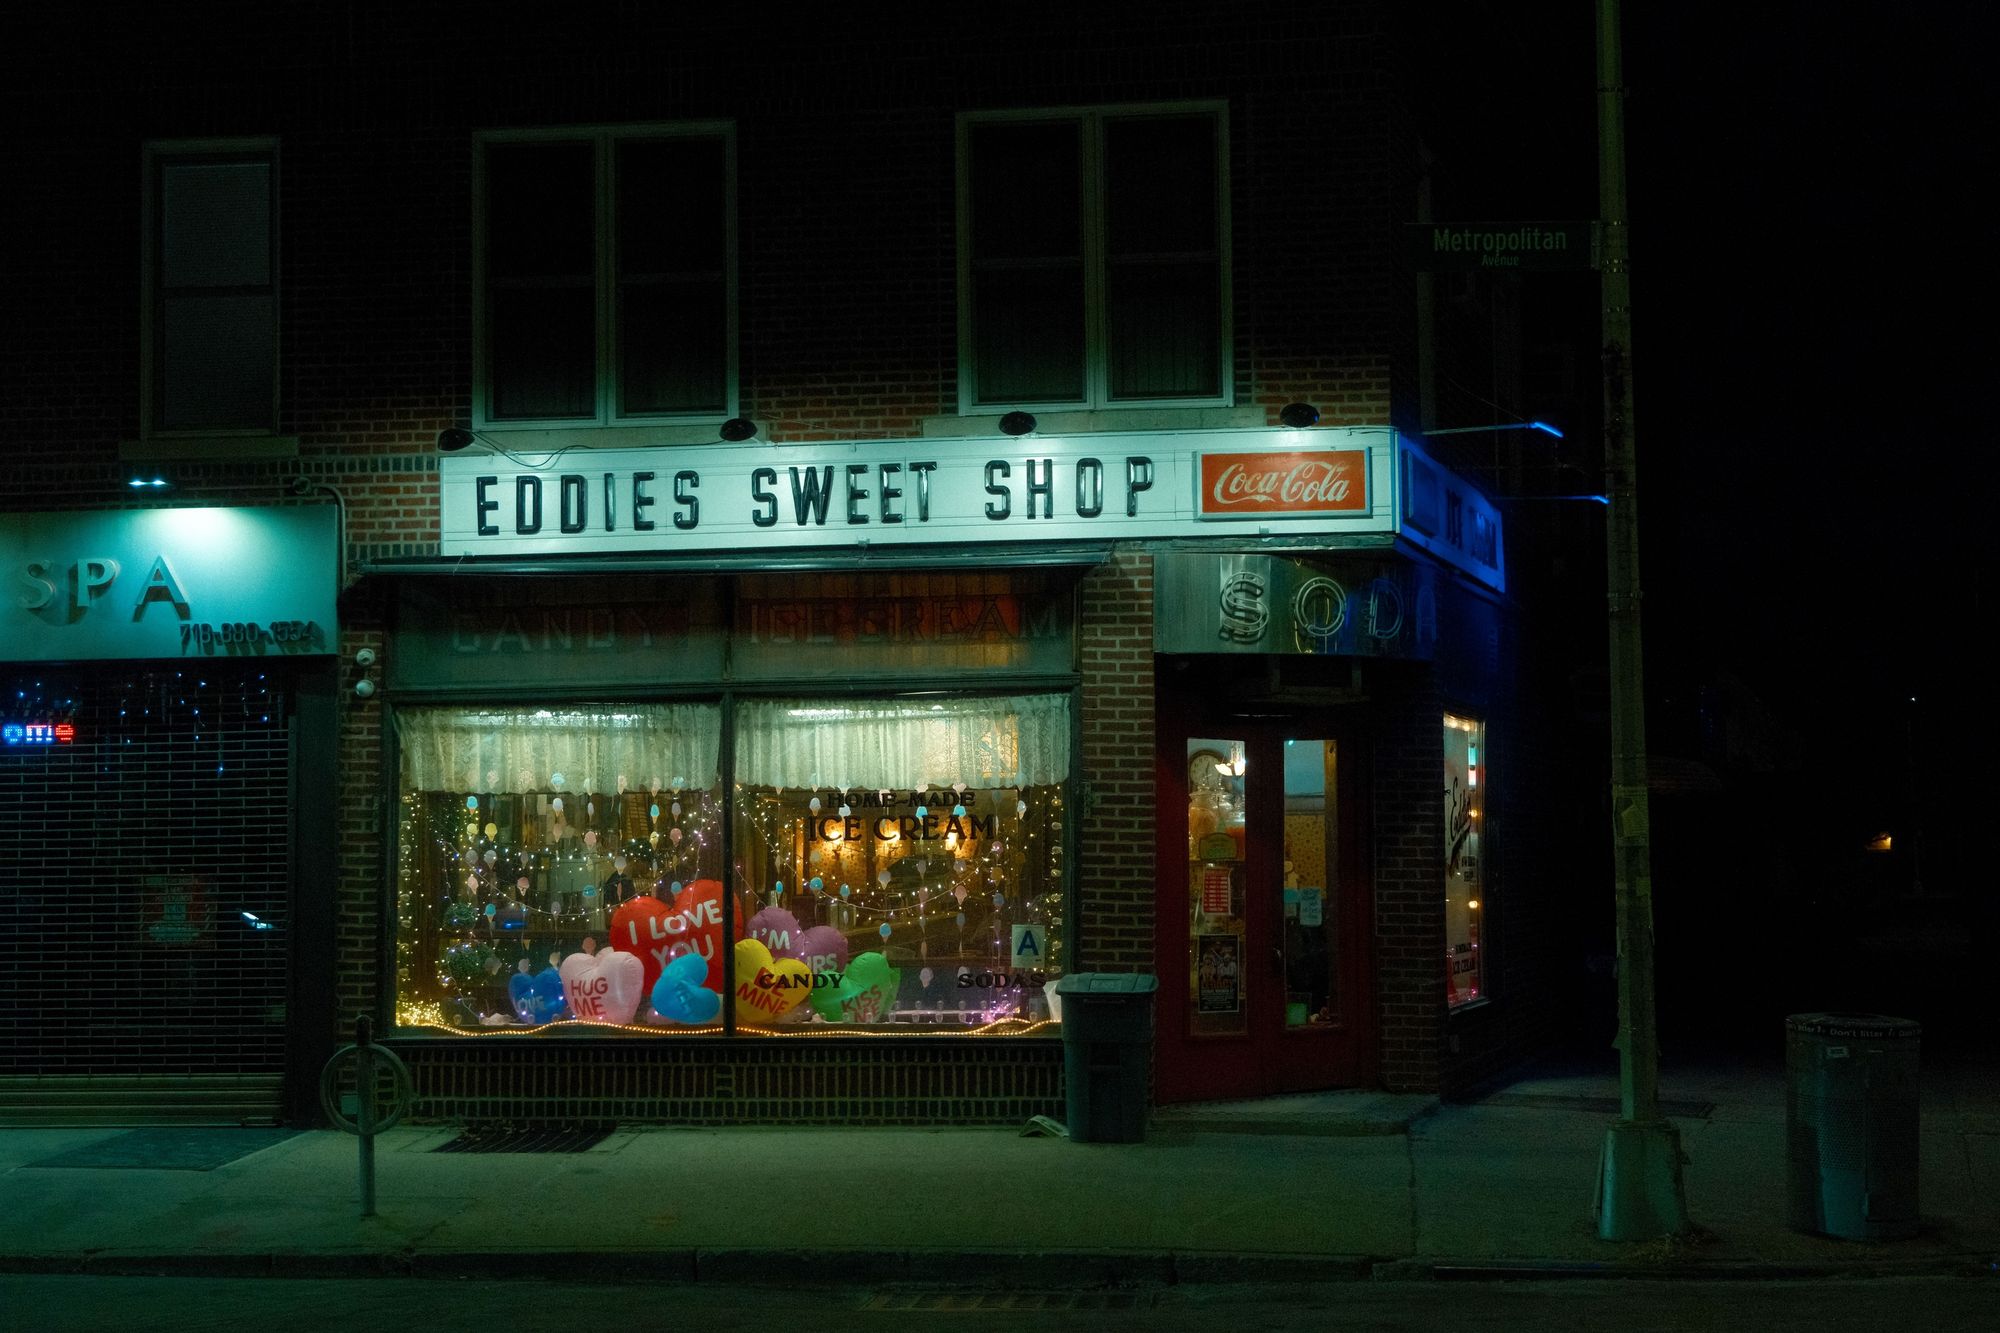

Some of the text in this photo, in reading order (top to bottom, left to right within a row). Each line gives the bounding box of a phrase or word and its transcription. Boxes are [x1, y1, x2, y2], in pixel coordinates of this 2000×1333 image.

[1433, 227, 1568, 256] Metropolitan
[1481, 253, 1520, 267] Avenue
[476, 456, 1153, 536] EDDIES SWEET SHOP
[1214, 461, 1350, 504] Coca-Cola
[20, 556, 190, 613] SPA
[452, 607, 653, 651] CANDY
[750, 597, 1059, 643] ICE CREAM
[828, 791, 976, 808] HOME-MADE
[808, 814, 995, 842] ICE CREAM
[629, 899, 723, 945] I LOVE
[1016, 930, 1039, 955] A
[571, 977, 608, 998] HUG
[759, 973, 844, 989] CANDY
[957, 973, 1047, 988] SODAS
[573, 997, 607, 1016] ME
[736, 982, 789, 1014] MINE
[841, 985, 882, 1012] KISS
